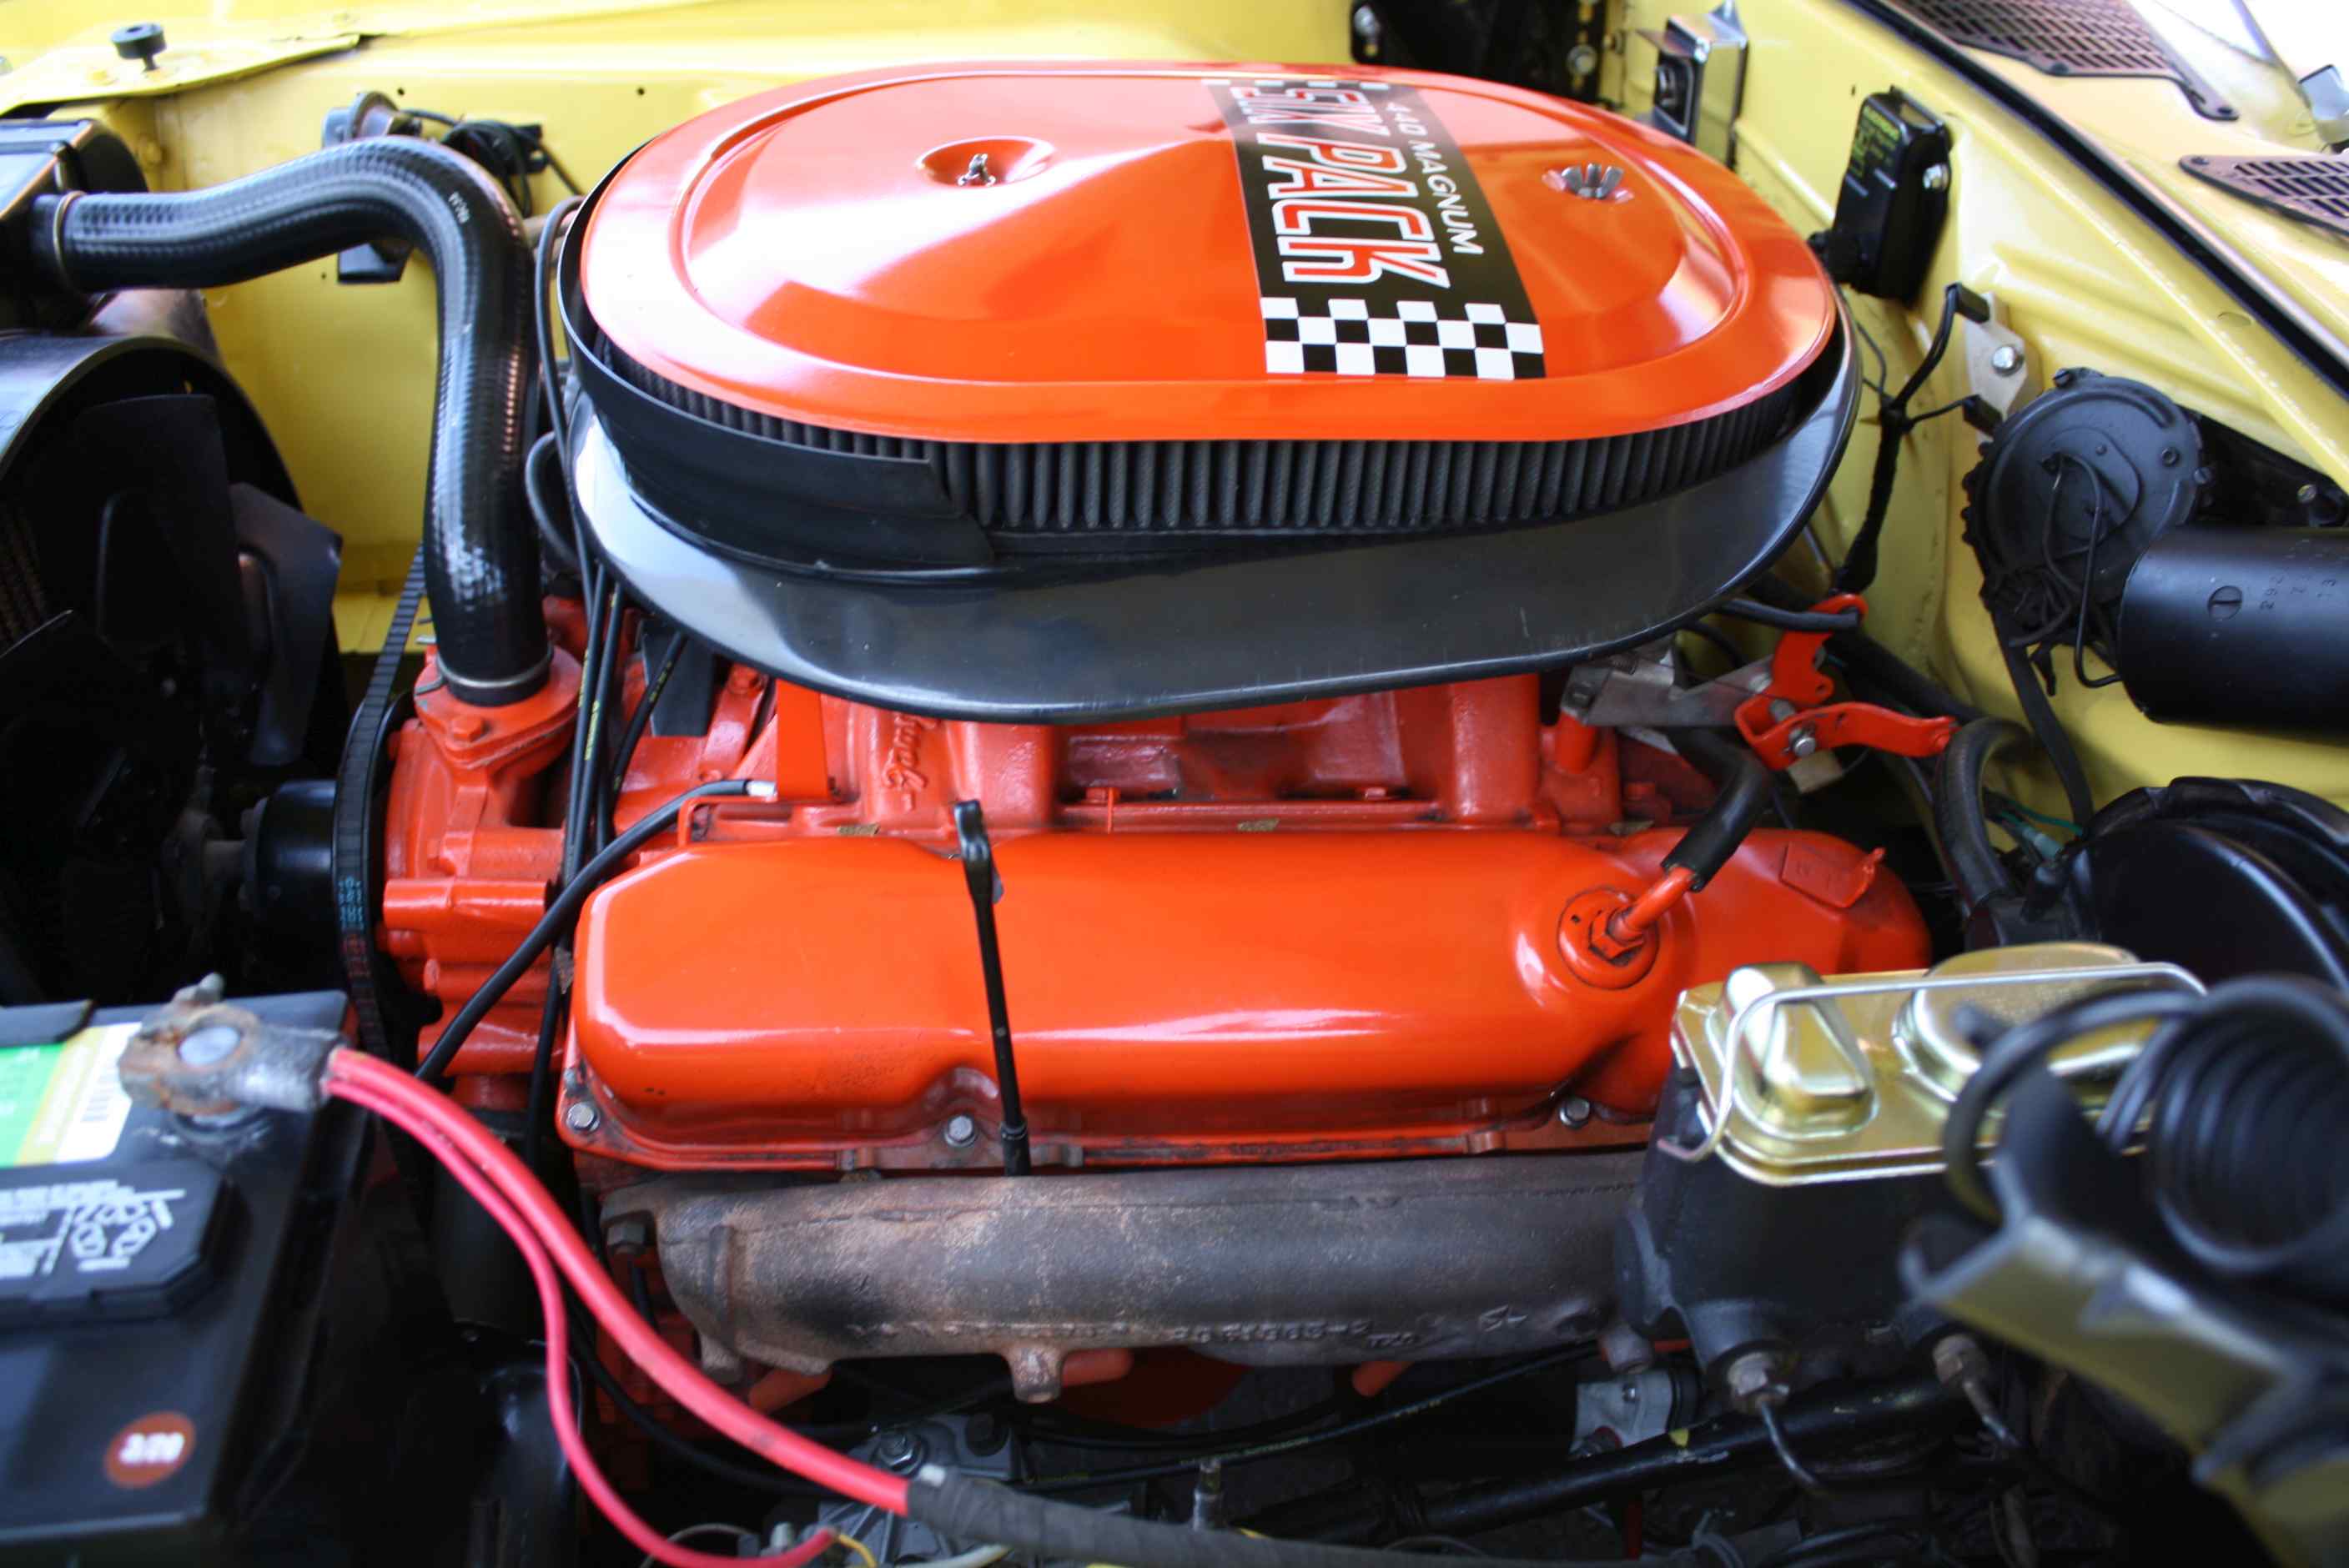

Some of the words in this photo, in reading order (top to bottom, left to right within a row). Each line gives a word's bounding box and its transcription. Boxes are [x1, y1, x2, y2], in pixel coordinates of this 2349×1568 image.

[1230, 86, 1391, 137] SIX
[1385, 101, 1428, 137] 440
[1408, 139, 1484, 255] MAGNUM
[1255, 131, 1451, 289] PACK
